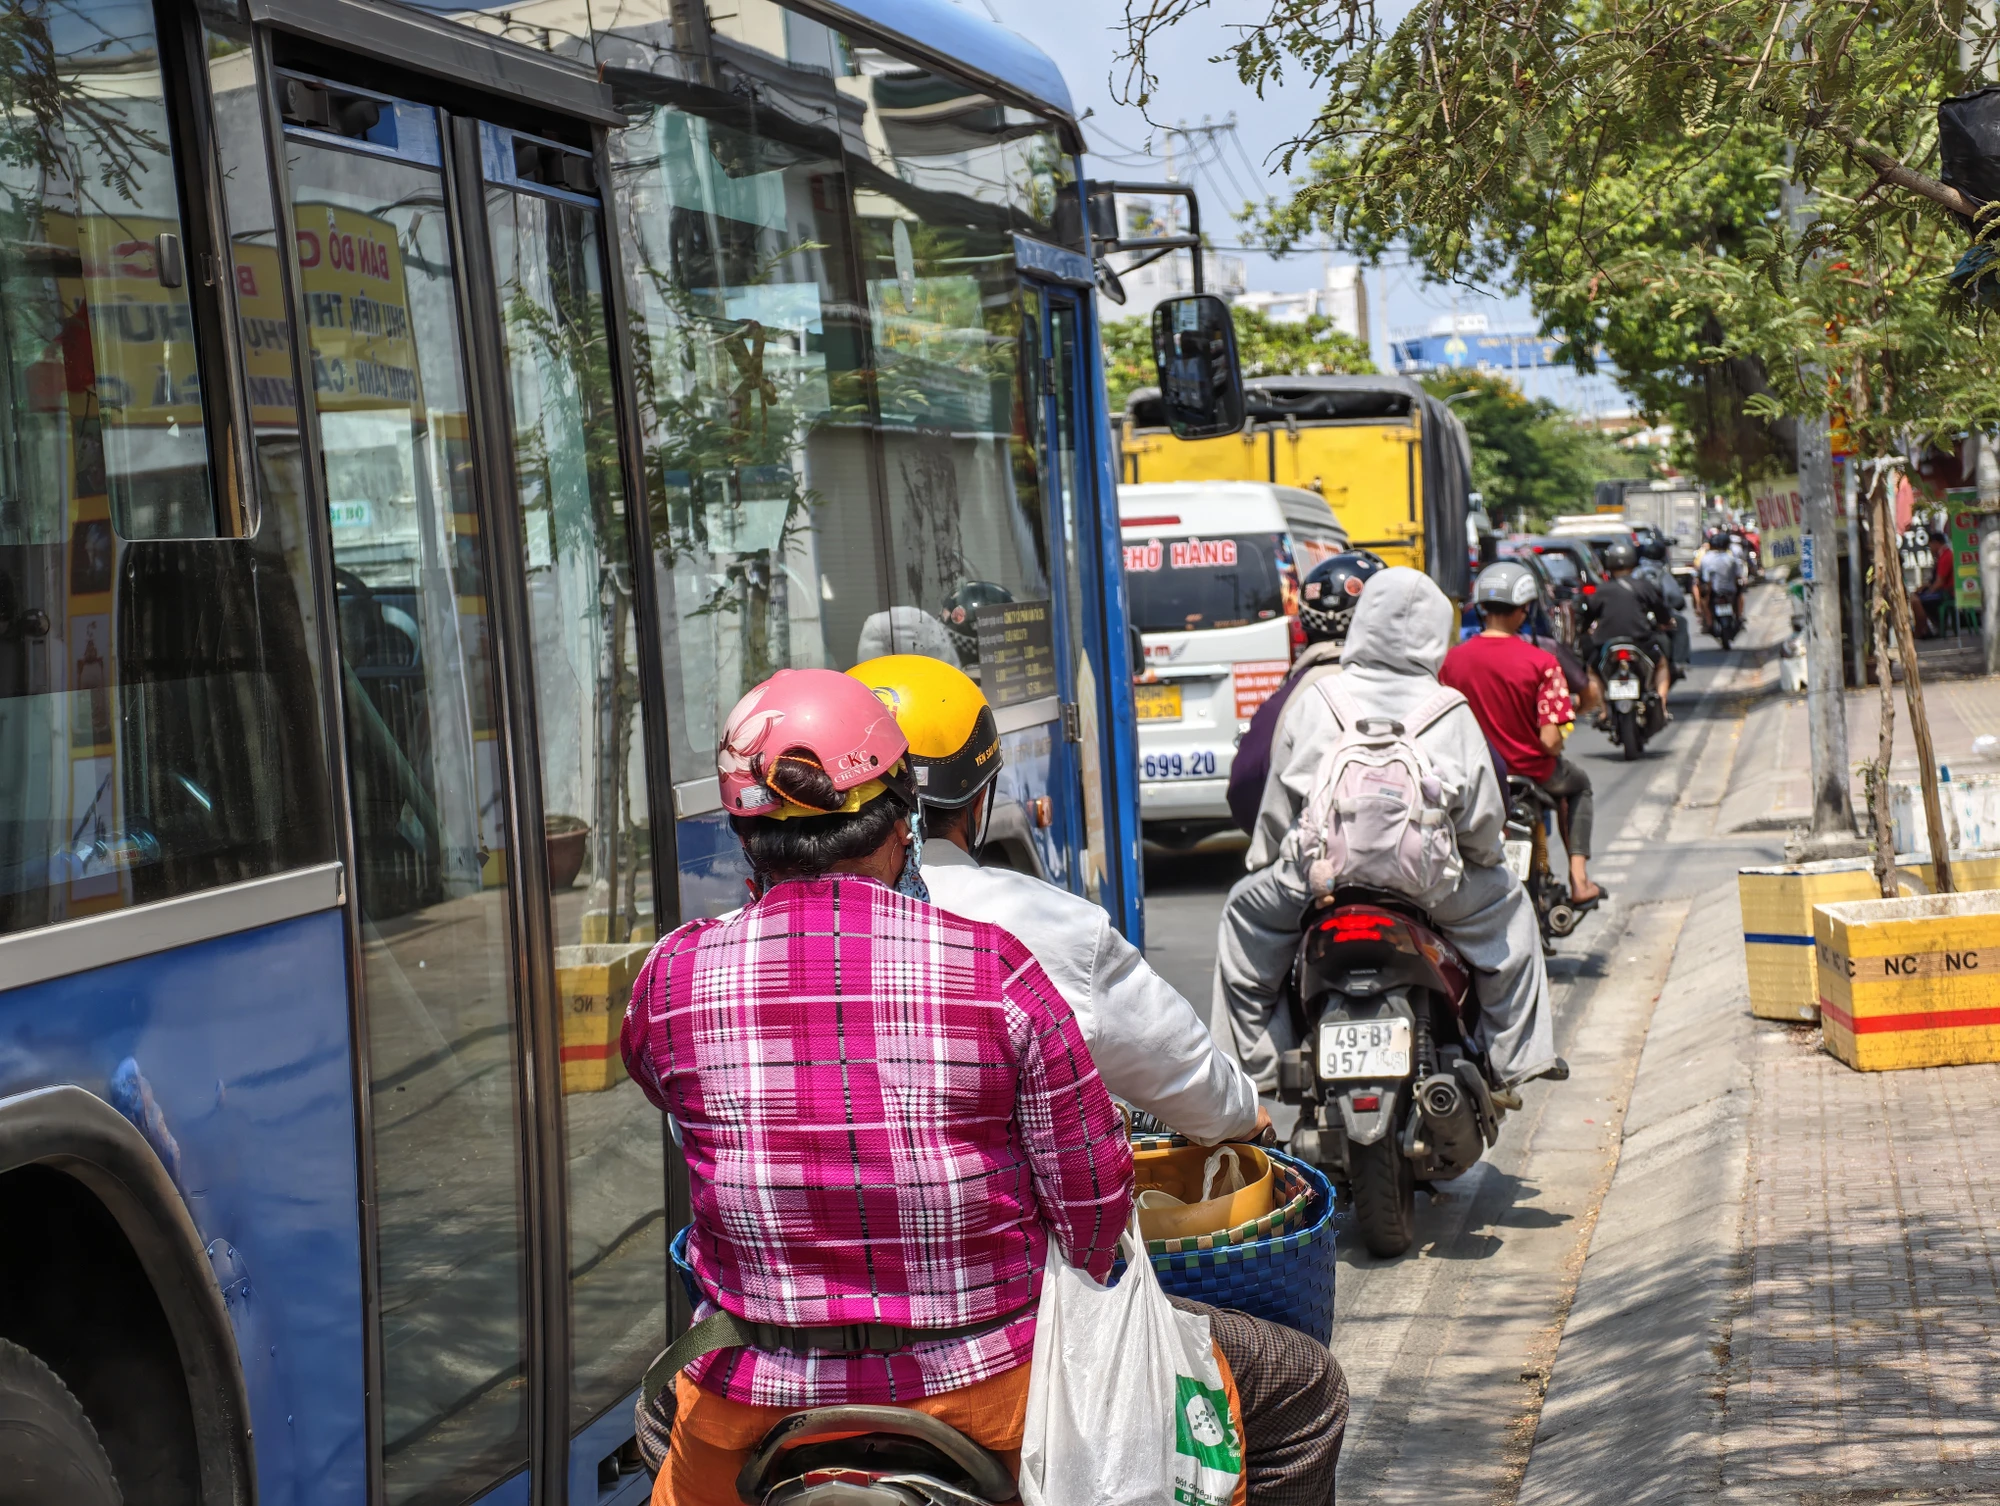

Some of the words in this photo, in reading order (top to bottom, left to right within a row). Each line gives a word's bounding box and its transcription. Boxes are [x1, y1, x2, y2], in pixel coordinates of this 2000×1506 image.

[1169, 536, 1238, 568] HÀNG
[837, 749, 870, 770] CKC
[1884, 956, 1918, 976] NC
[1945, 951, 1980, 972] NC
